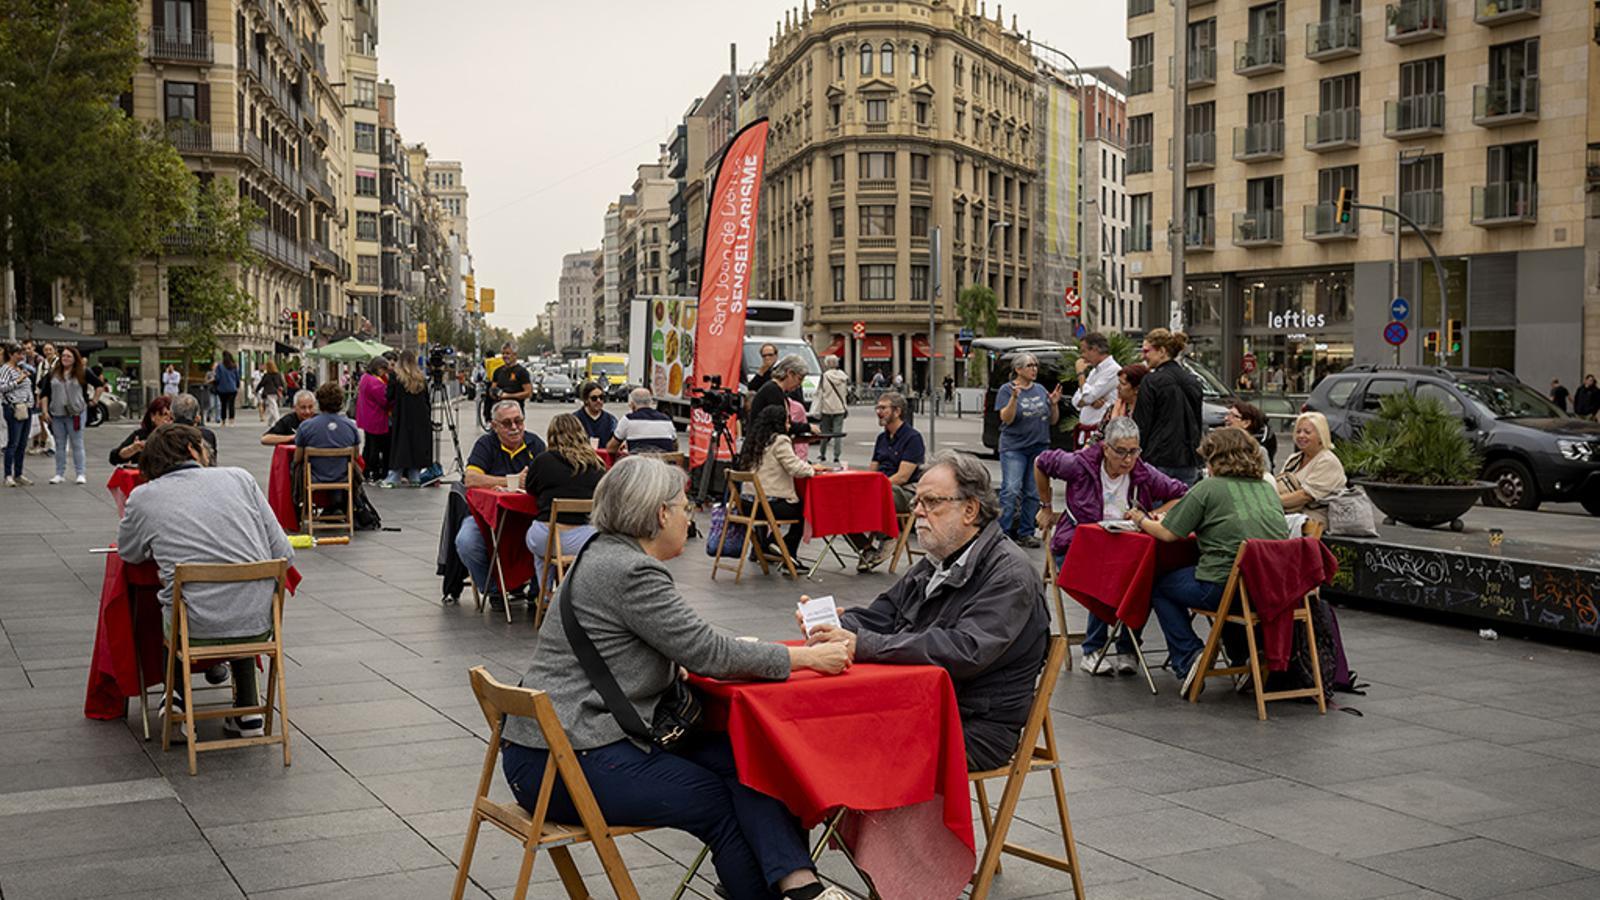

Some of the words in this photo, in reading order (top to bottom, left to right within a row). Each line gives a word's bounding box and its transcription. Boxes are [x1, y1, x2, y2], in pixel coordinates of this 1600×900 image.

[709, 295, 729, 336] Sant
[720, 221, 735, 245] de
[730, 154, 758, 314] SENSELLARISME
[1268, 308, 1325, 329] lefties
